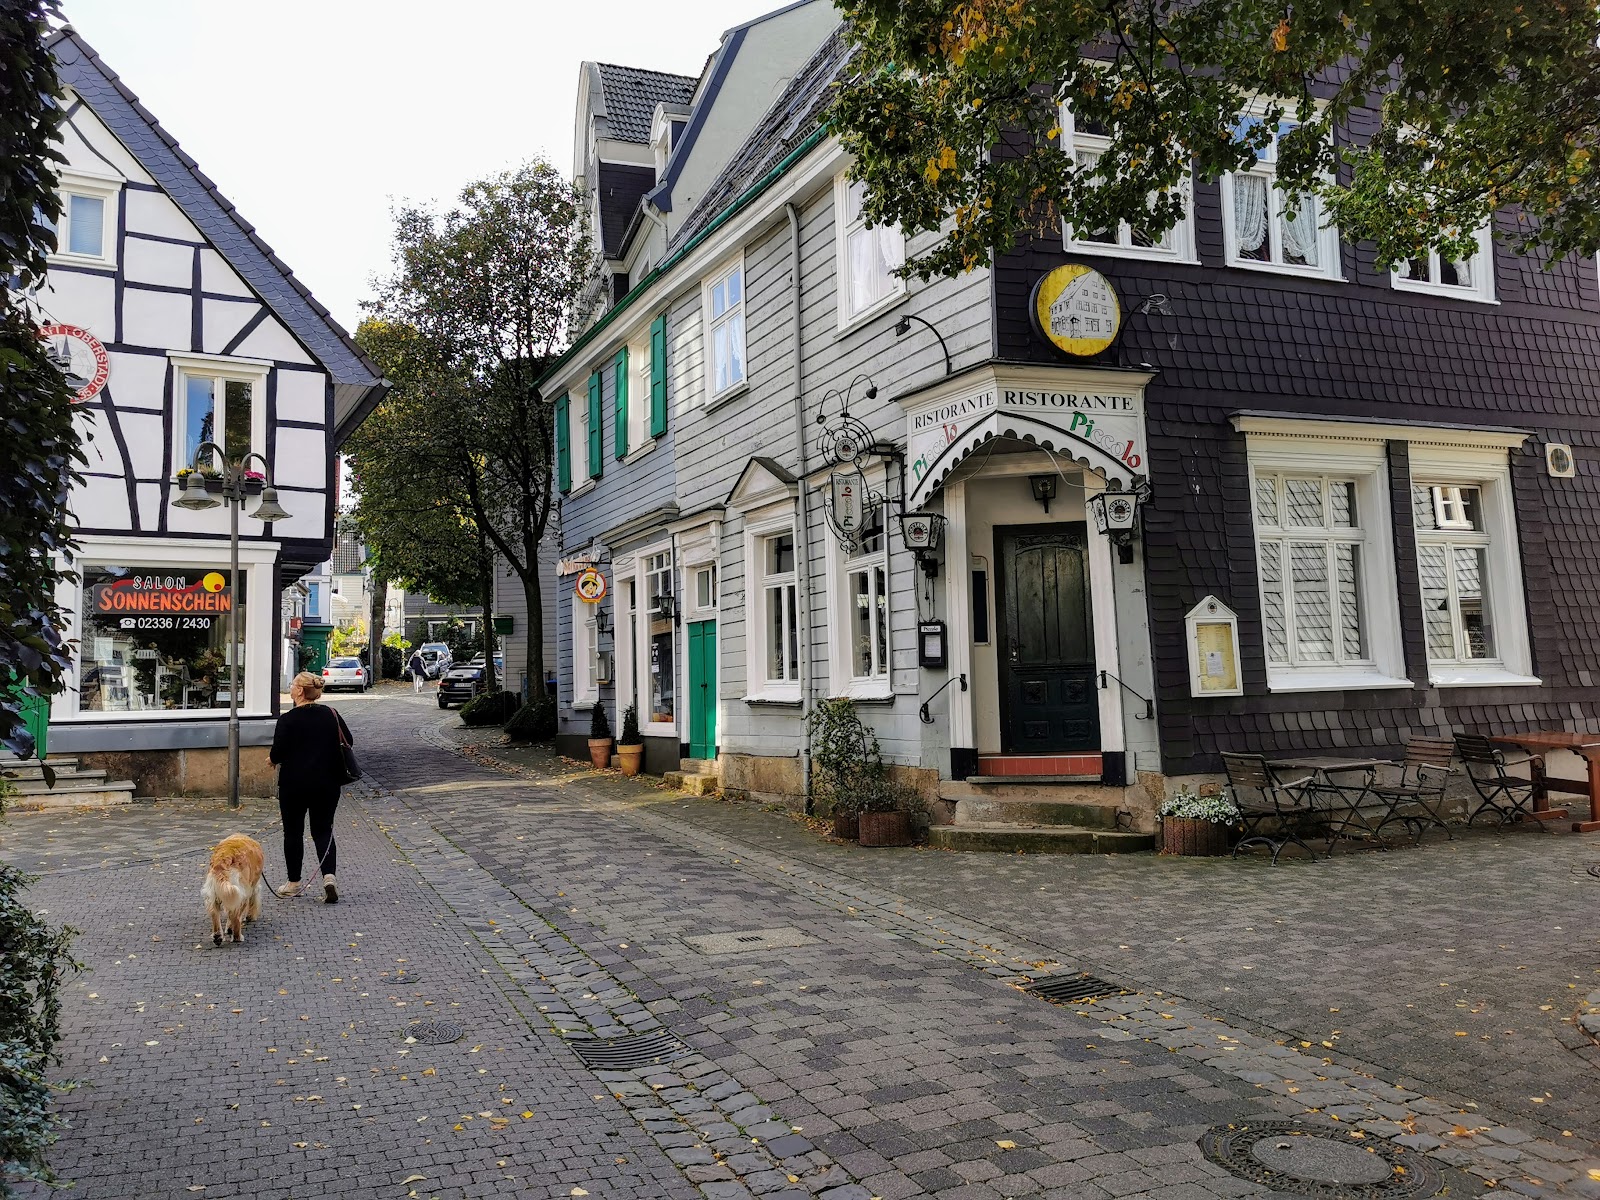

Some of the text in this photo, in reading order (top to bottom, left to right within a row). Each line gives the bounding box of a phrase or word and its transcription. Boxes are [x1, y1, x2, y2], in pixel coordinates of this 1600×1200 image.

[72, 328, 108, 391] OBERSTADT
[915, 391, 994, 430] RISTORANTE
[1004, 391, 1134, 411] RISTORANTE
[912, 422, 958, 481] Piccolo
[1069, 411, 1141, 468] Piccolo
[841, 486, 854, 528] Piccolo
[99, 587, 231, 611] SONNENSCHEIN
[133, 575, 186, 590] SALON
[137, 617, 211, 629] 02336 / 2430
